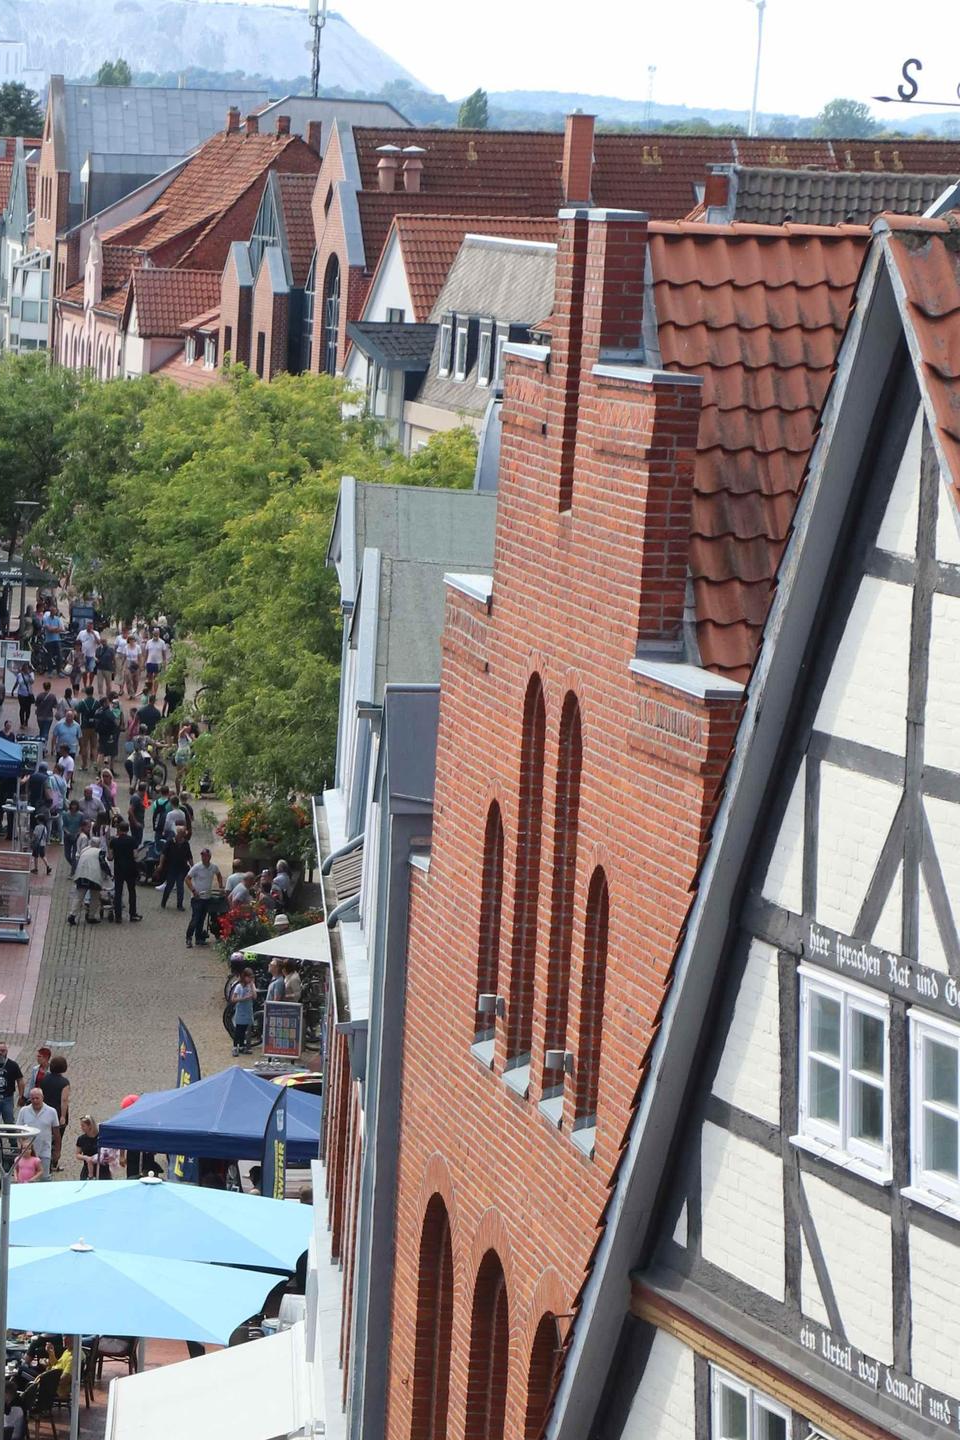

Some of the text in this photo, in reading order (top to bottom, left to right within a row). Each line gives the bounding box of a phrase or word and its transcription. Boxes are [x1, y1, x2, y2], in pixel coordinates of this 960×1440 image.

[897, 58, 922, 101] S
[809, 924, 831, 958] hier
[916, 973, 939, 999] und
[800, 1324, 816, 1351] ein
